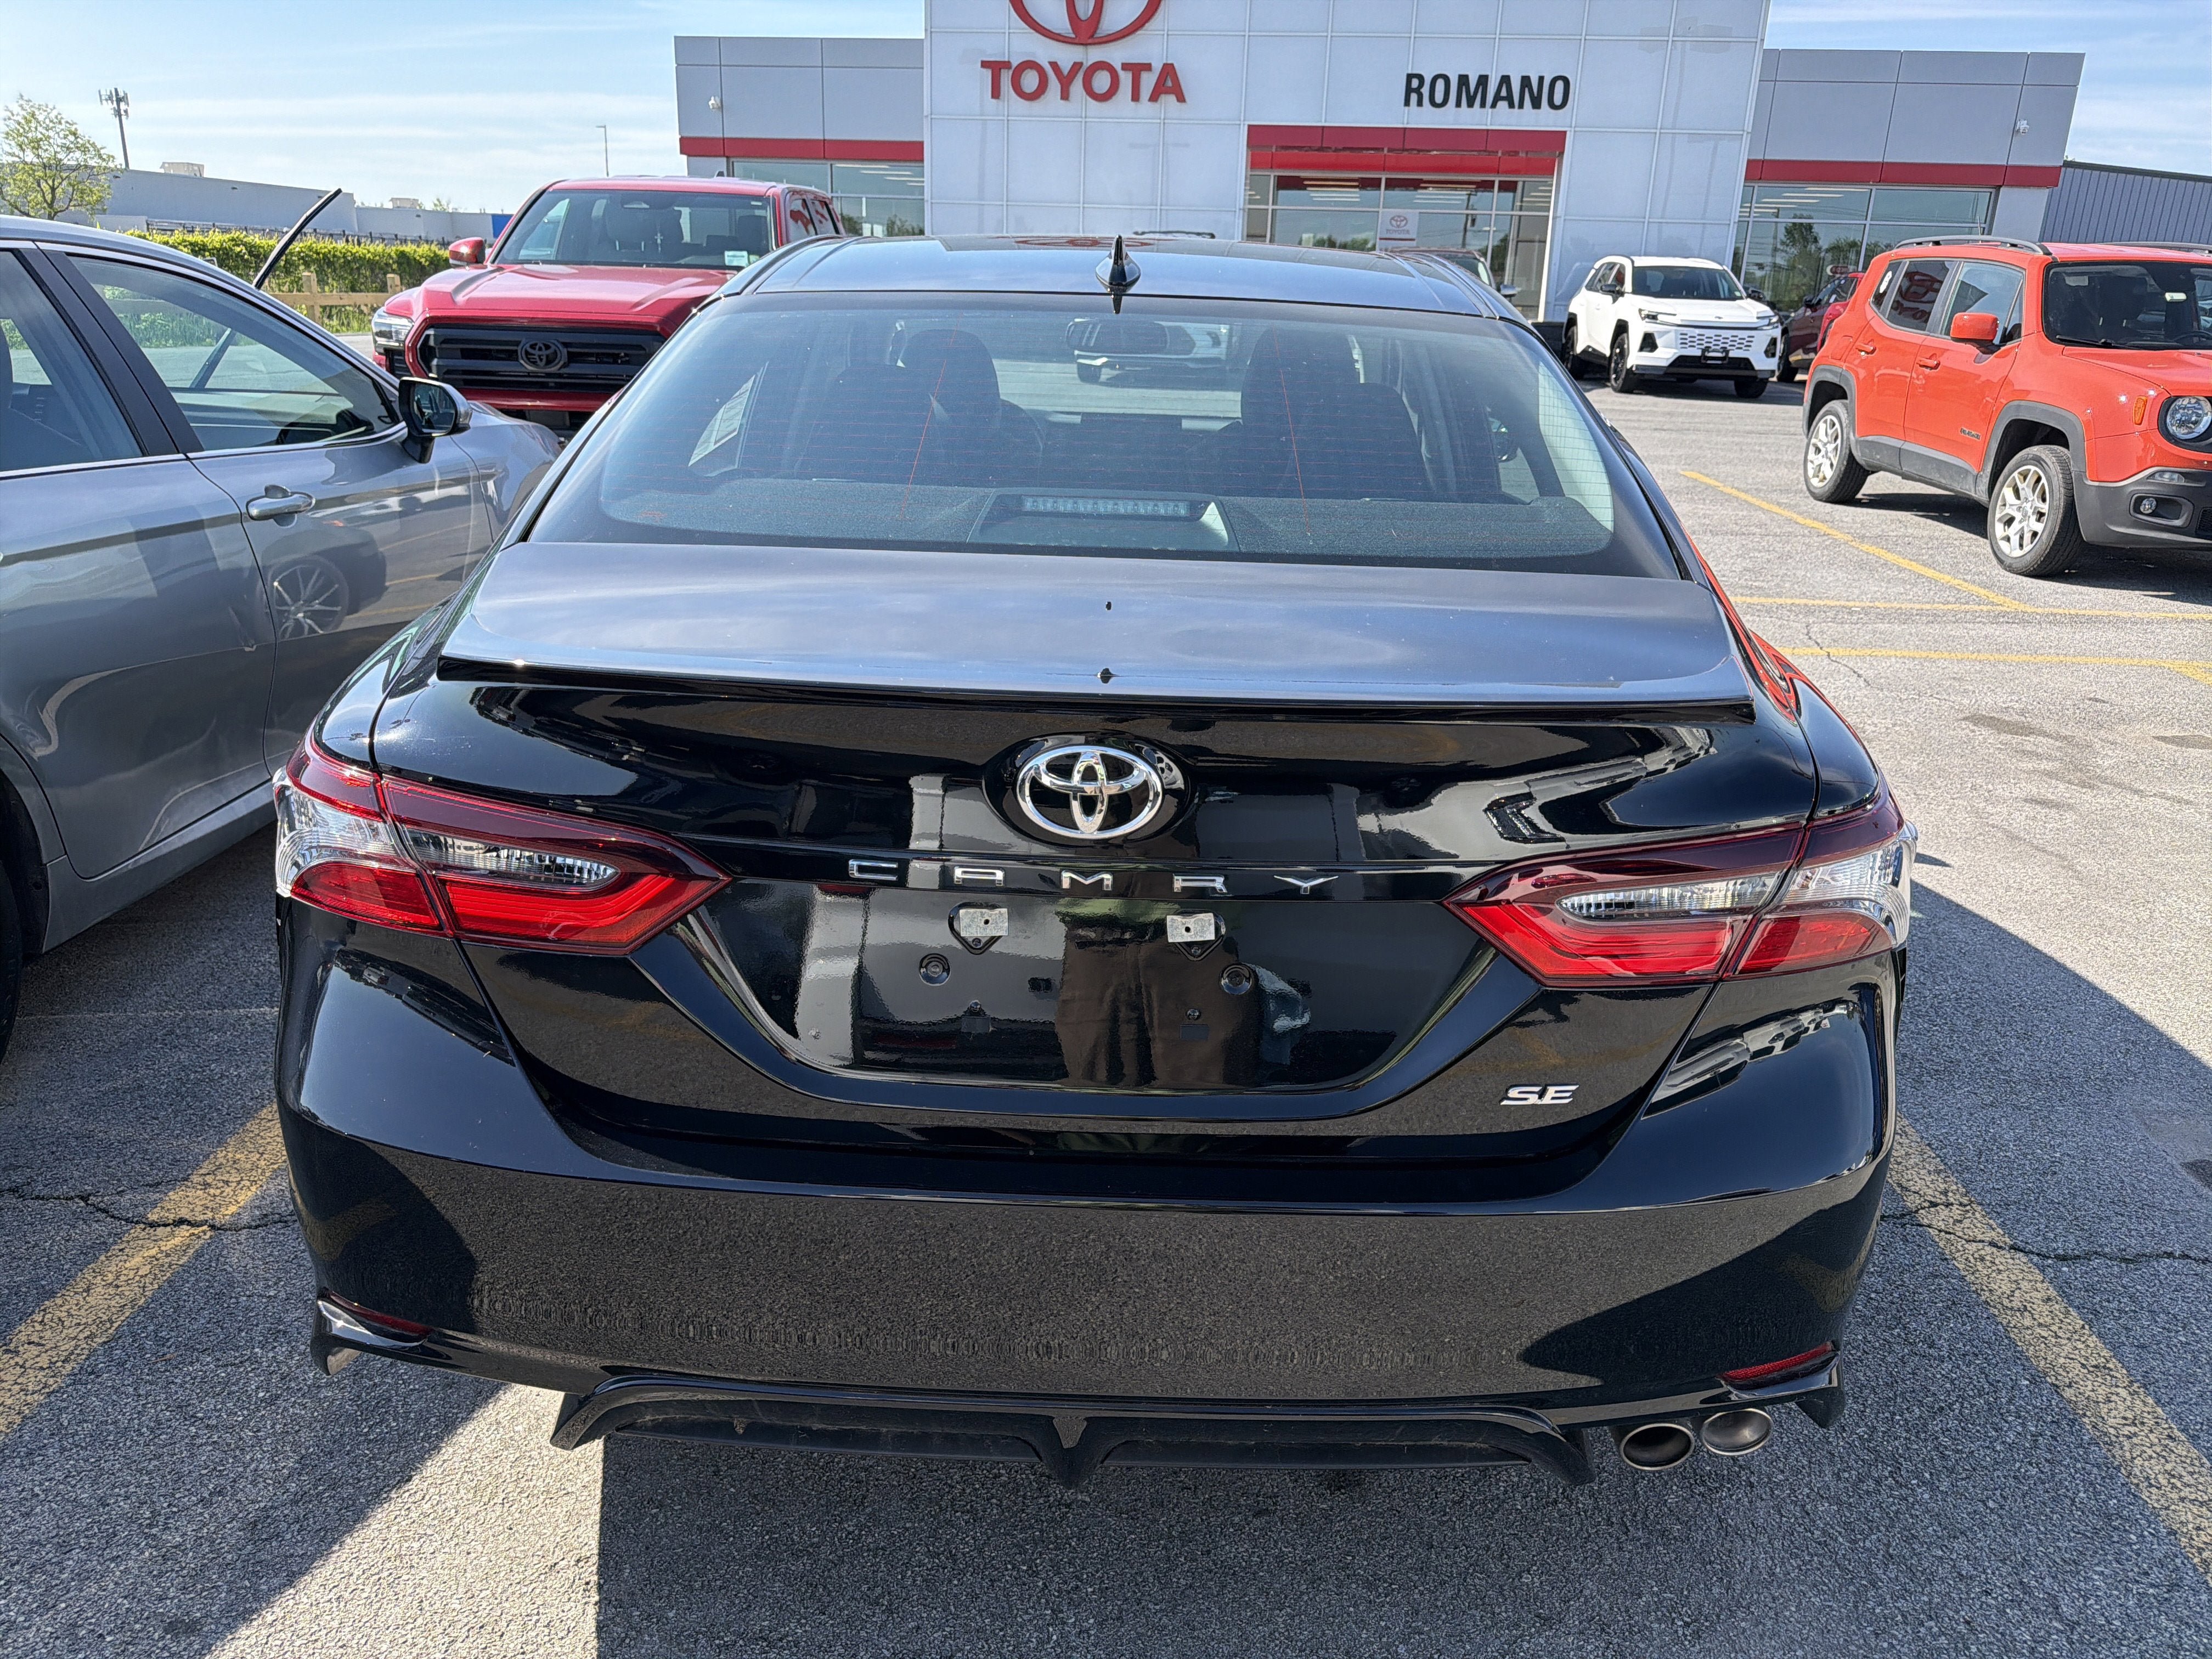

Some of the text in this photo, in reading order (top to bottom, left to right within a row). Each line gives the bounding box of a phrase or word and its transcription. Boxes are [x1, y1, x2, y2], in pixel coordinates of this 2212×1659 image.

[980, 60, 1186, 103] TOYOTA
[1403, 73, 1571, 110] ROMANO
[848, 859, 1339, 894] CAMRY
[1500, 1084, 1580, 1105] SE
